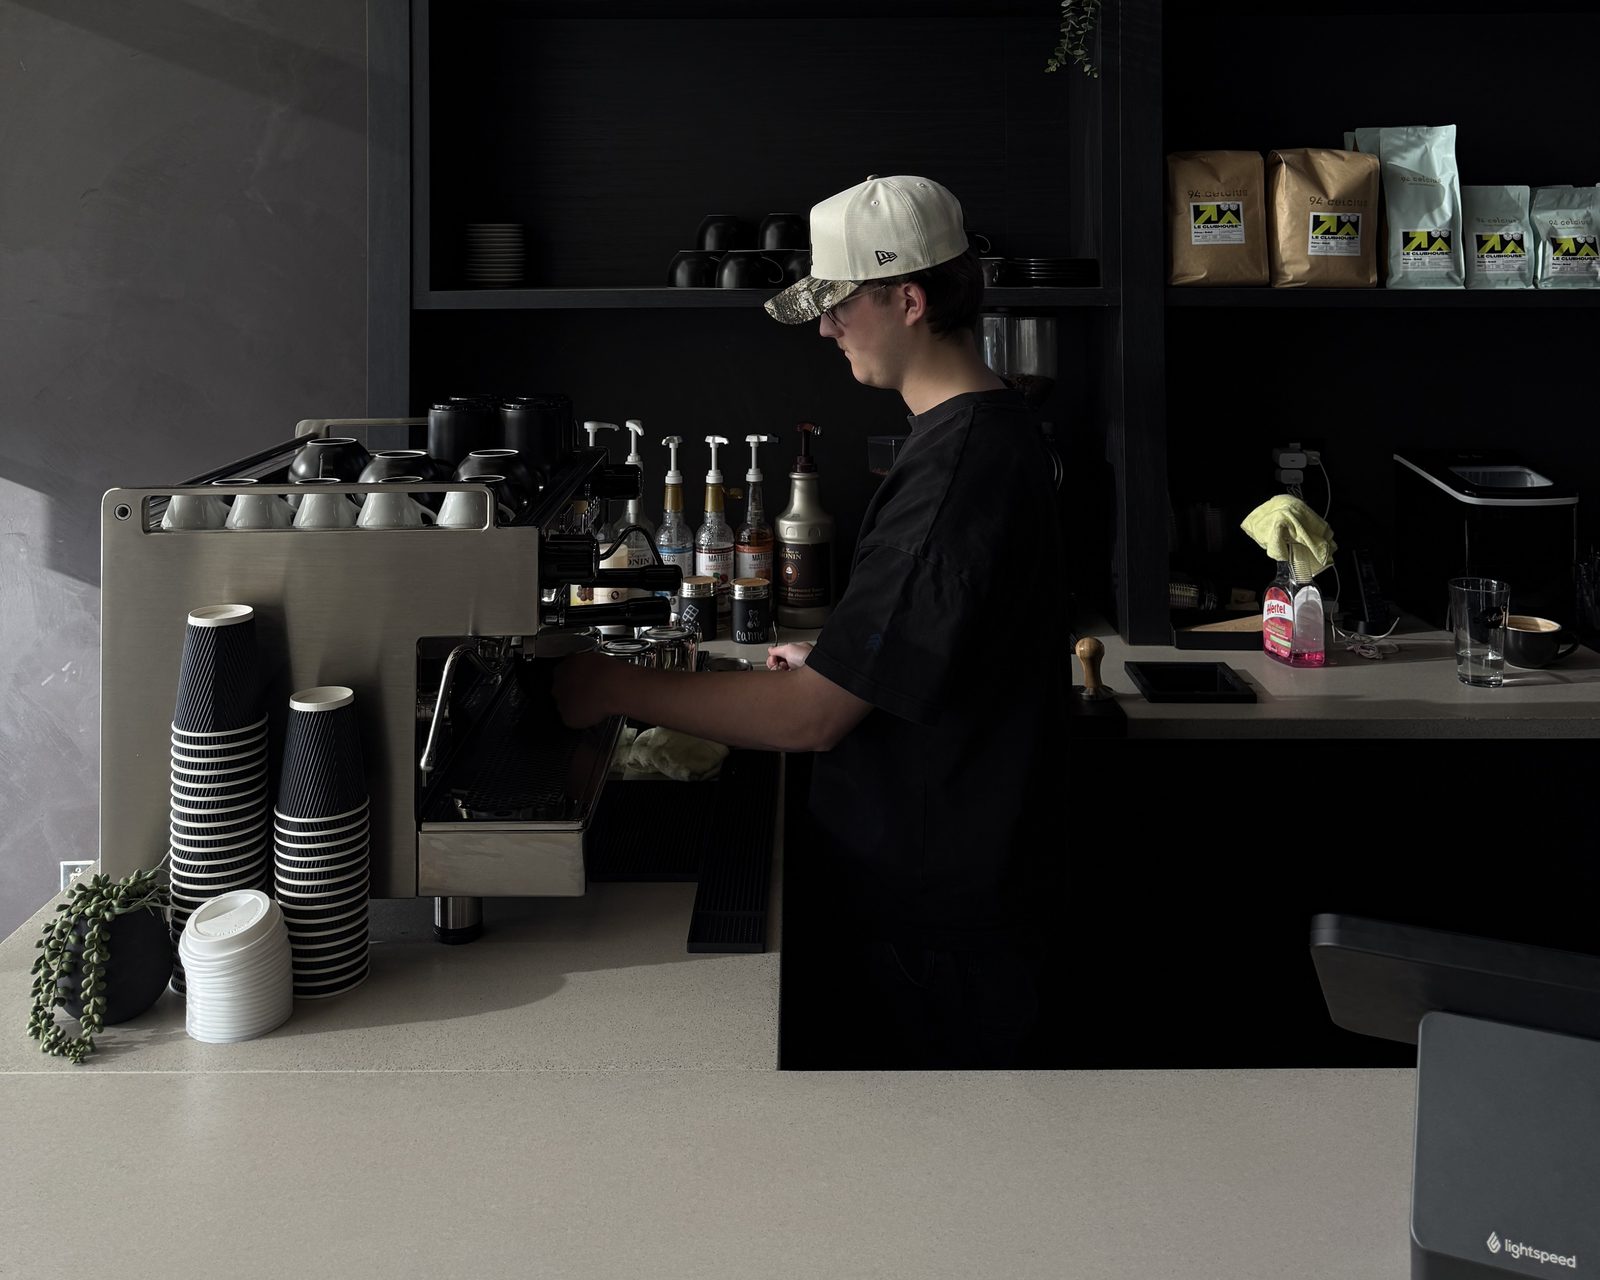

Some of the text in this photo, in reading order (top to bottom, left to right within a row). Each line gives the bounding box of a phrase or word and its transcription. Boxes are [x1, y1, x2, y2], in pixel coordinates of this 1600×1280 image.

[1309, 196, 1323, 206] 94
[1267, 602, 1286, 615] Hertel
[1504, 1238, 1576, 1269] lightspeed
